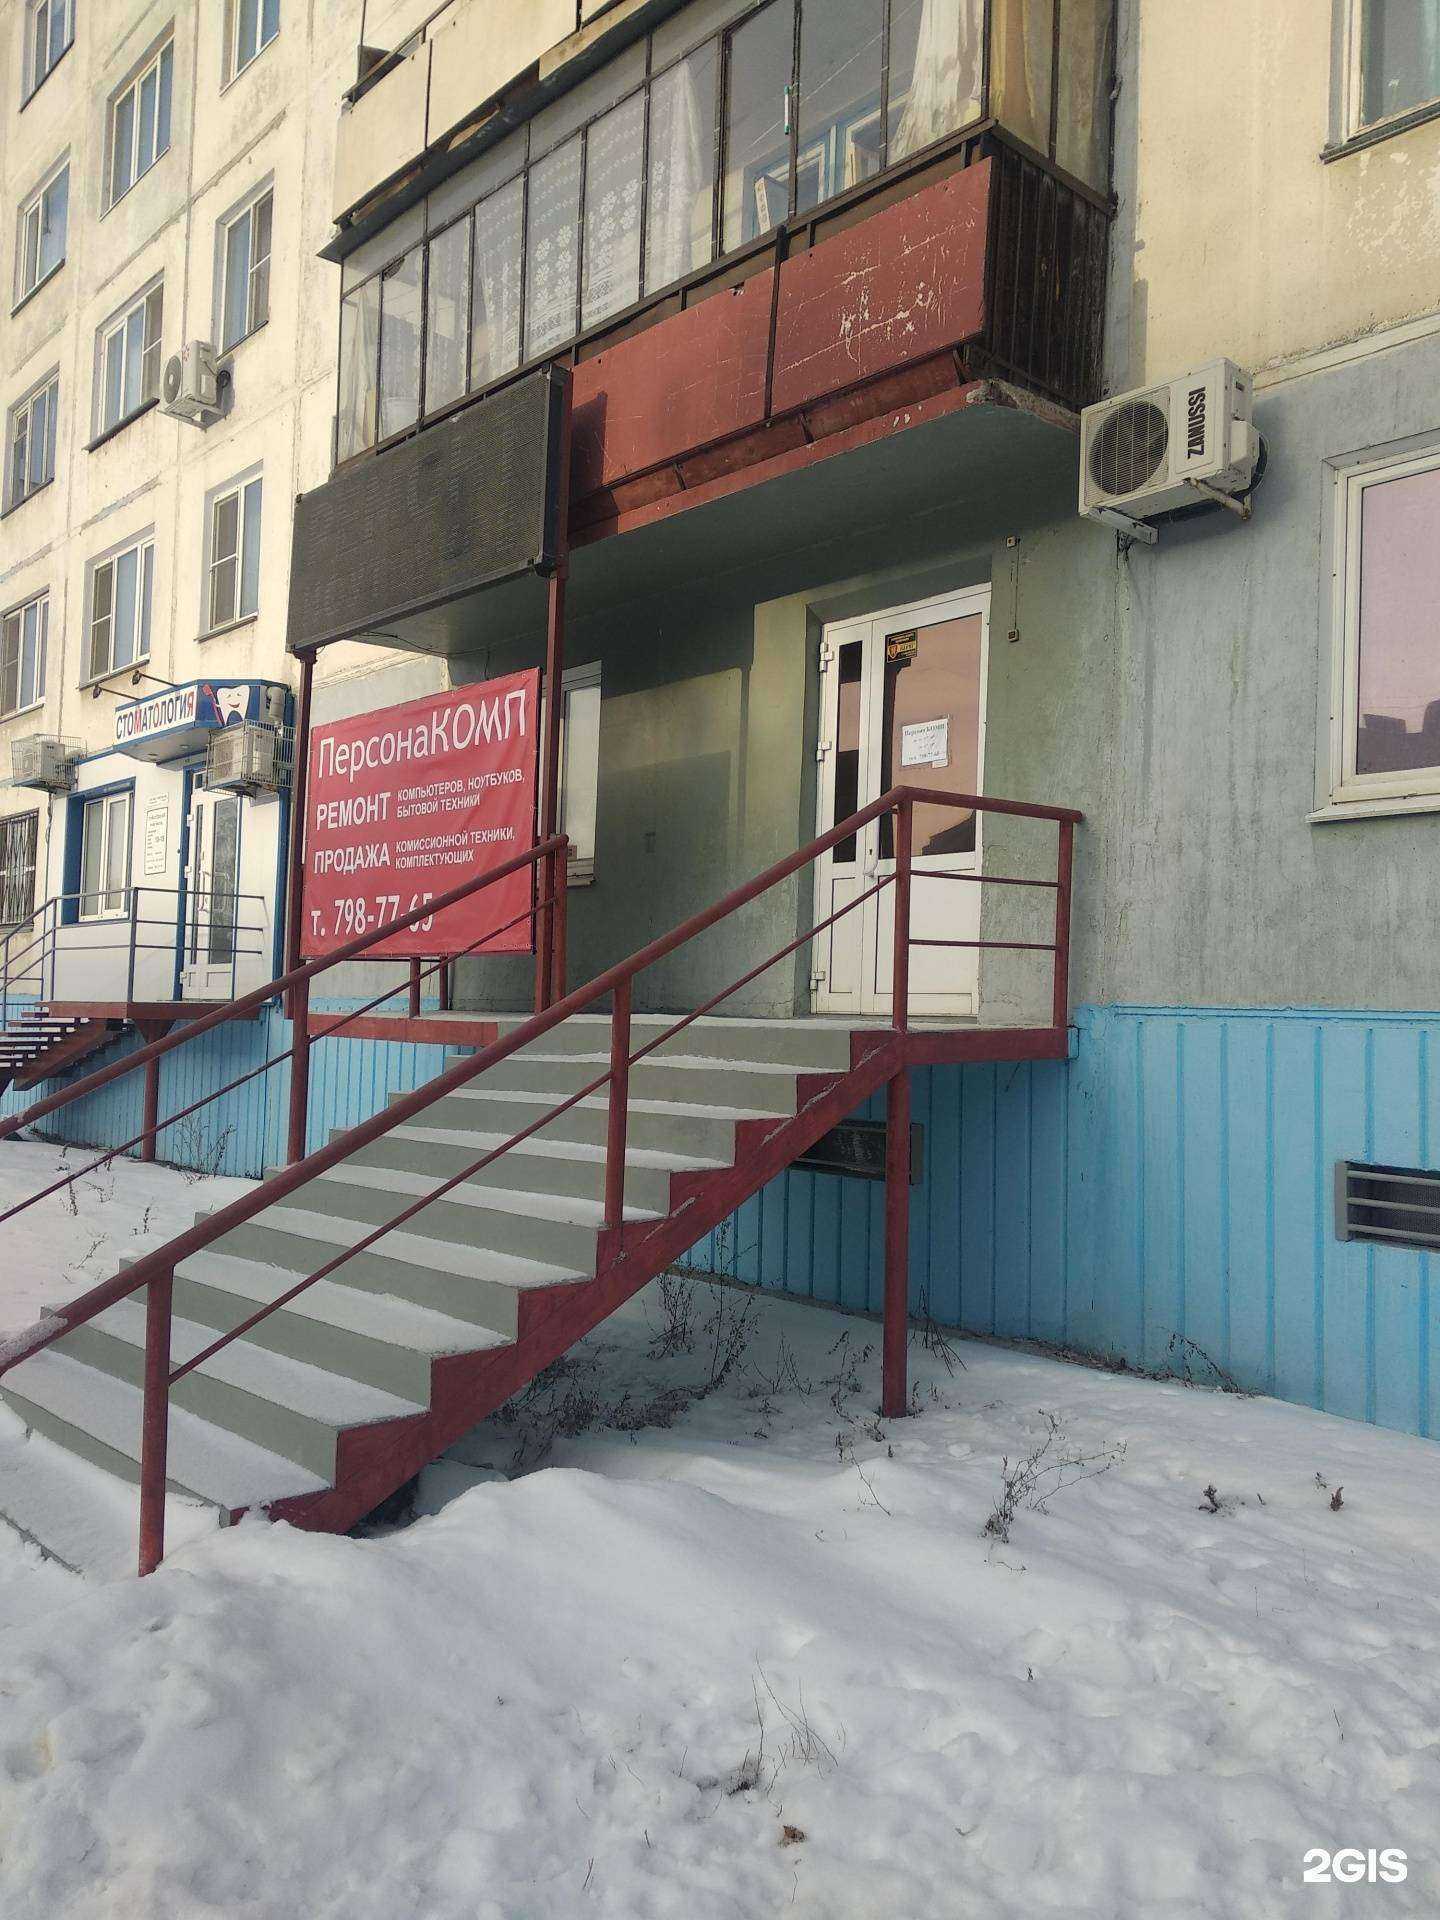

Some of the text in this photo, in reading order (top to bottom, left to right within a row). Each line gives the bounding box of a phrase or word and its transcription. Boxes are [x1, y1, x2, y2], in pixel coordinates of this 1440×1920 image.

[1187, 386, 1206, 459] ZANUSSI
[116, 691, 195, 739] СТОМАТОЛОГИЯ
[318, 688, 526, 782] ПерсонаКОМП
[397, 768, 525, 802] КОМПЬЮТЕРОВ, НОУТБУКОВ,
[316, 792, 391, 830] РЕМОНТ
[396, 793, 481, 818] БЫТОВОЙ ТЕХНИКИ
[395, 826, 516, 853] КОМИССИОННОЙ ТЕХНИКИ,
[314, 842, 391, 875] ПРОДАЖА
[395, 849, 475, 870] КОМПЛЕКТУЮЩИХ
